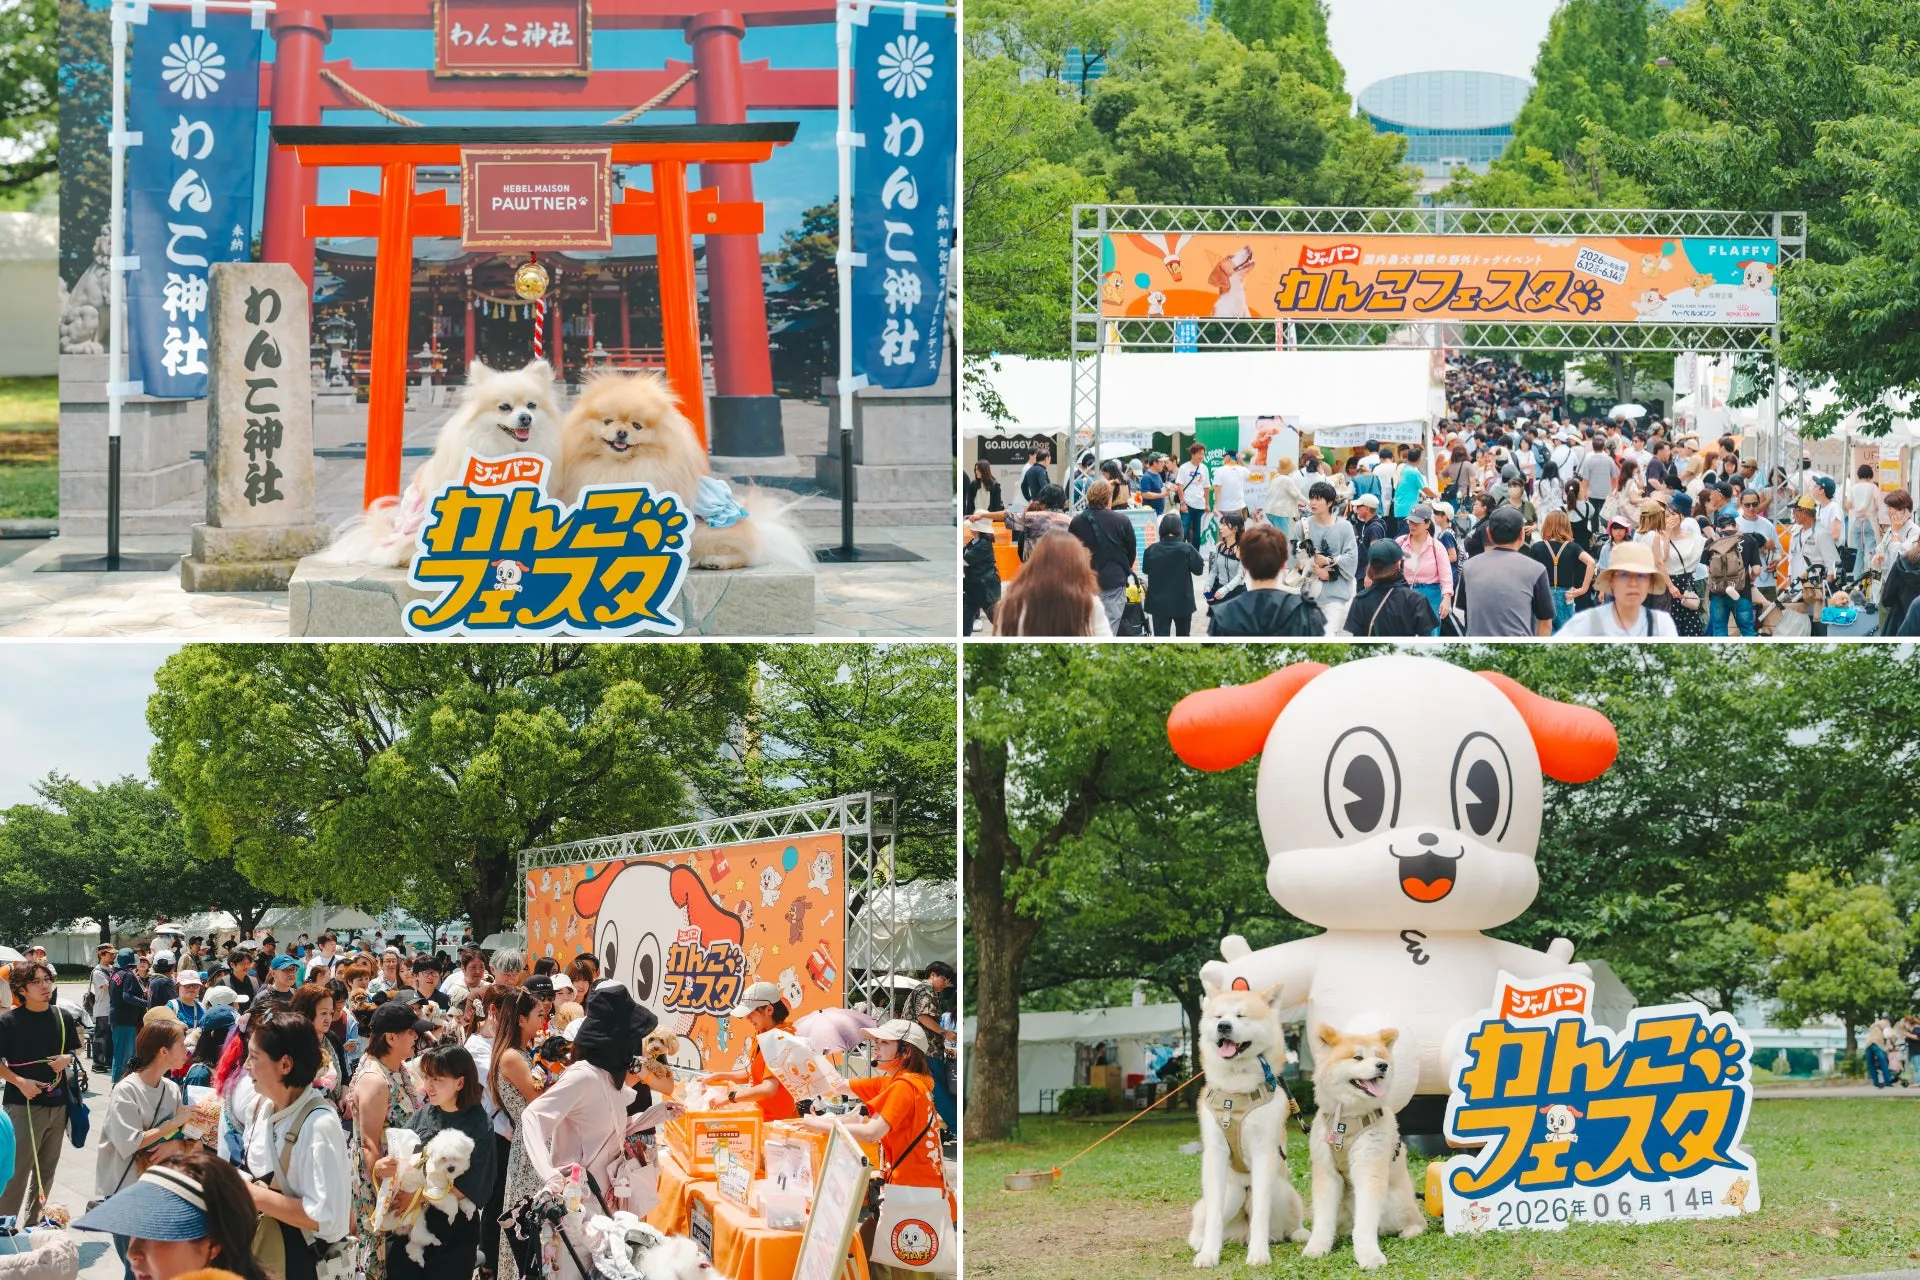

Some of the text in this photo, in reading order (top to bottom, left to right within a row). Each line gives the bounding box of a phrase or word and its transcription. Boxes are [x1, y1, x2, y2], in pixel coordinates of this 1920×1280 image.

[450, 21, 575, 48] わんこ神社
[492, 196, 577, 211] PAWTNER
[503, 184, 570, 193] HEBEL MAISON
[161, 113, 215, 377] わんこ神社
[879, 111, 925, 367] わんこ神社
[1708, 245, 1771, 257] FLAFFY
[1305, 246, 1360, 266] ジャパン
[1580, 249, 1604, 265] 2026
[1274, 267, 1577, 315] わんこフェスタ
[242, 285, 285, 507] わんこ神社
[473, 458, 542, 484] ジャパン
[424, 487, 648, 553] わんこ
[409, 554, 676, 630] フェスタ
[666, 942, 732, 973] わんこ
[663, 974, 739, 1010] フェスタ
[1510, 986, 1586, 1015] ジャパン
[1459, 1015, 1700, 1102] わんこ
[1450, 1088, 1740, 1196] フェスタ
[900, 1250, 931, 1260] STAFF
